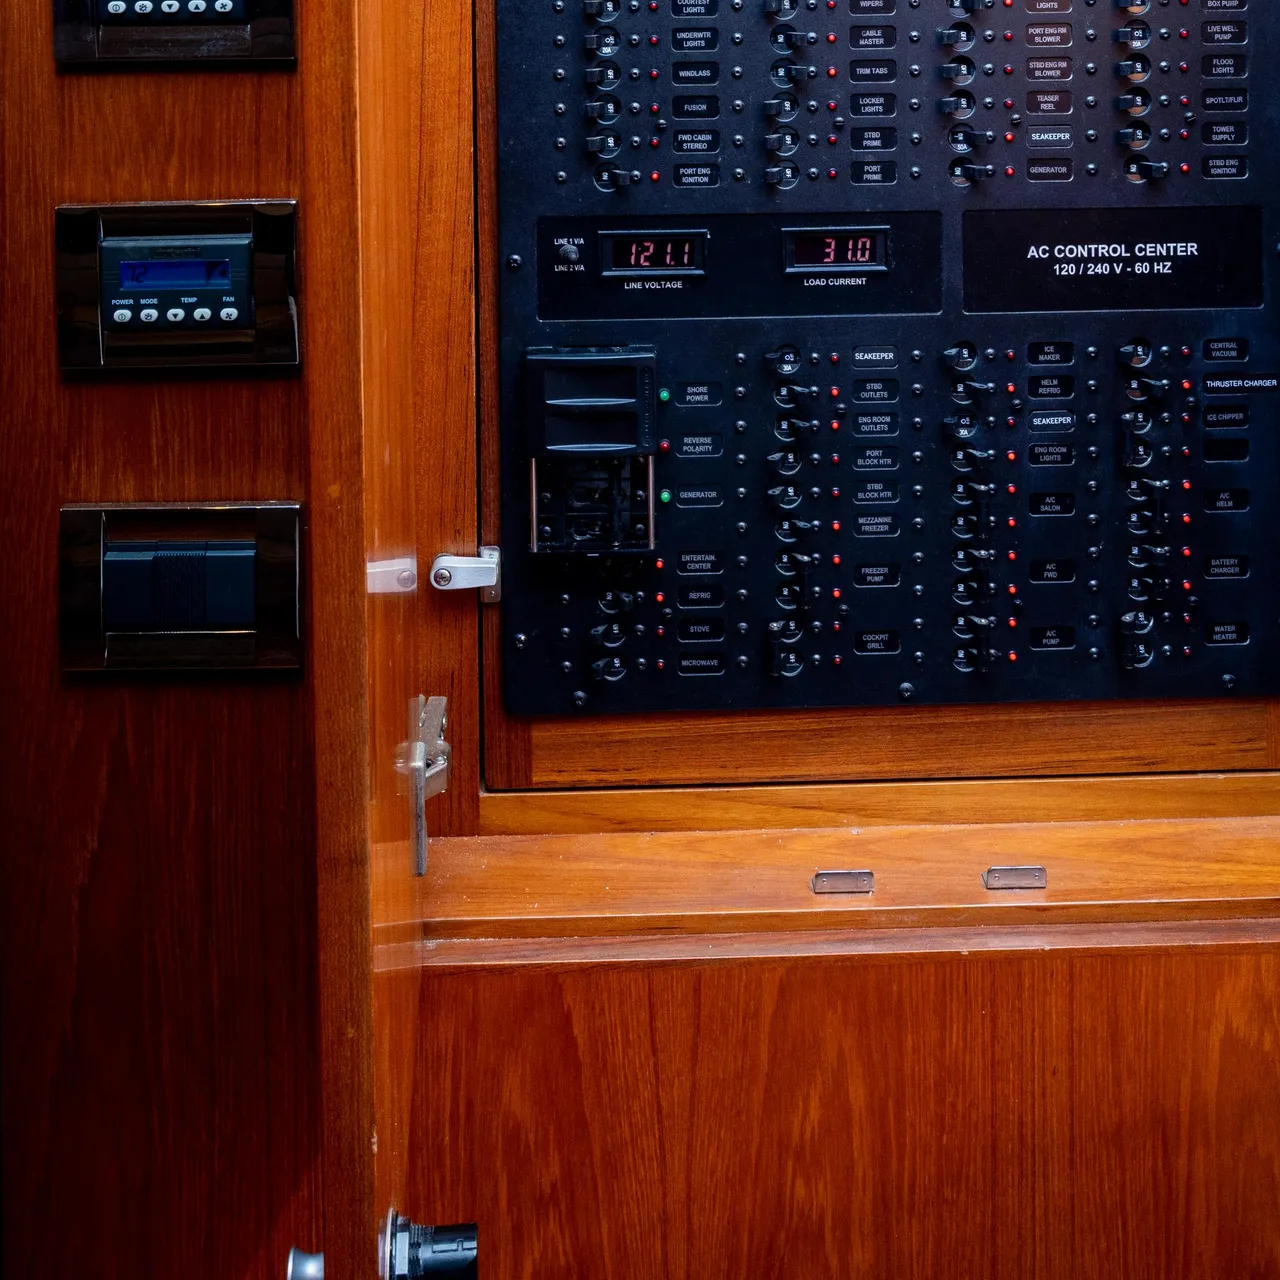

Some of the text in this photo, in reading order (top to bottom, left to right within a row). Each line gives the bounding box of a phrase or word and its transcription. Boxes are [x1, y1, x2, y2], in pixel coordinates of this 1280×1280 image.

[629, 241, 690, 266] 121.1
[823, 238, 871, 262] 31.0
[1027, 243, 1198, 259] AC CONTROL CENTER
[1053, 264, 1076, 275] 120
[1079, 263, 1084, 275] /
[1087, 263, 1110, 275] 240
[1114, 263, 1124, 274] V
[1134, 262, 1150, 274] 60
[1154, 262, 1172, 273] HZ
[644, 281, 683, 289] VOLTAGE
[803, 277, 867, 286] LOAD CURRENT
[854, 352, 894, 360] SEAKEEPER
[1206, 379, 1277, 388] THRUSTER CHARGER
[1032, 417, 1071, 425] SEAKEEPER
[679, 491, 717, 499] GENERATOR
[858, 516, 892, 524] MEZZANINE
[681, 659, 718, 667] MICROWAVE
